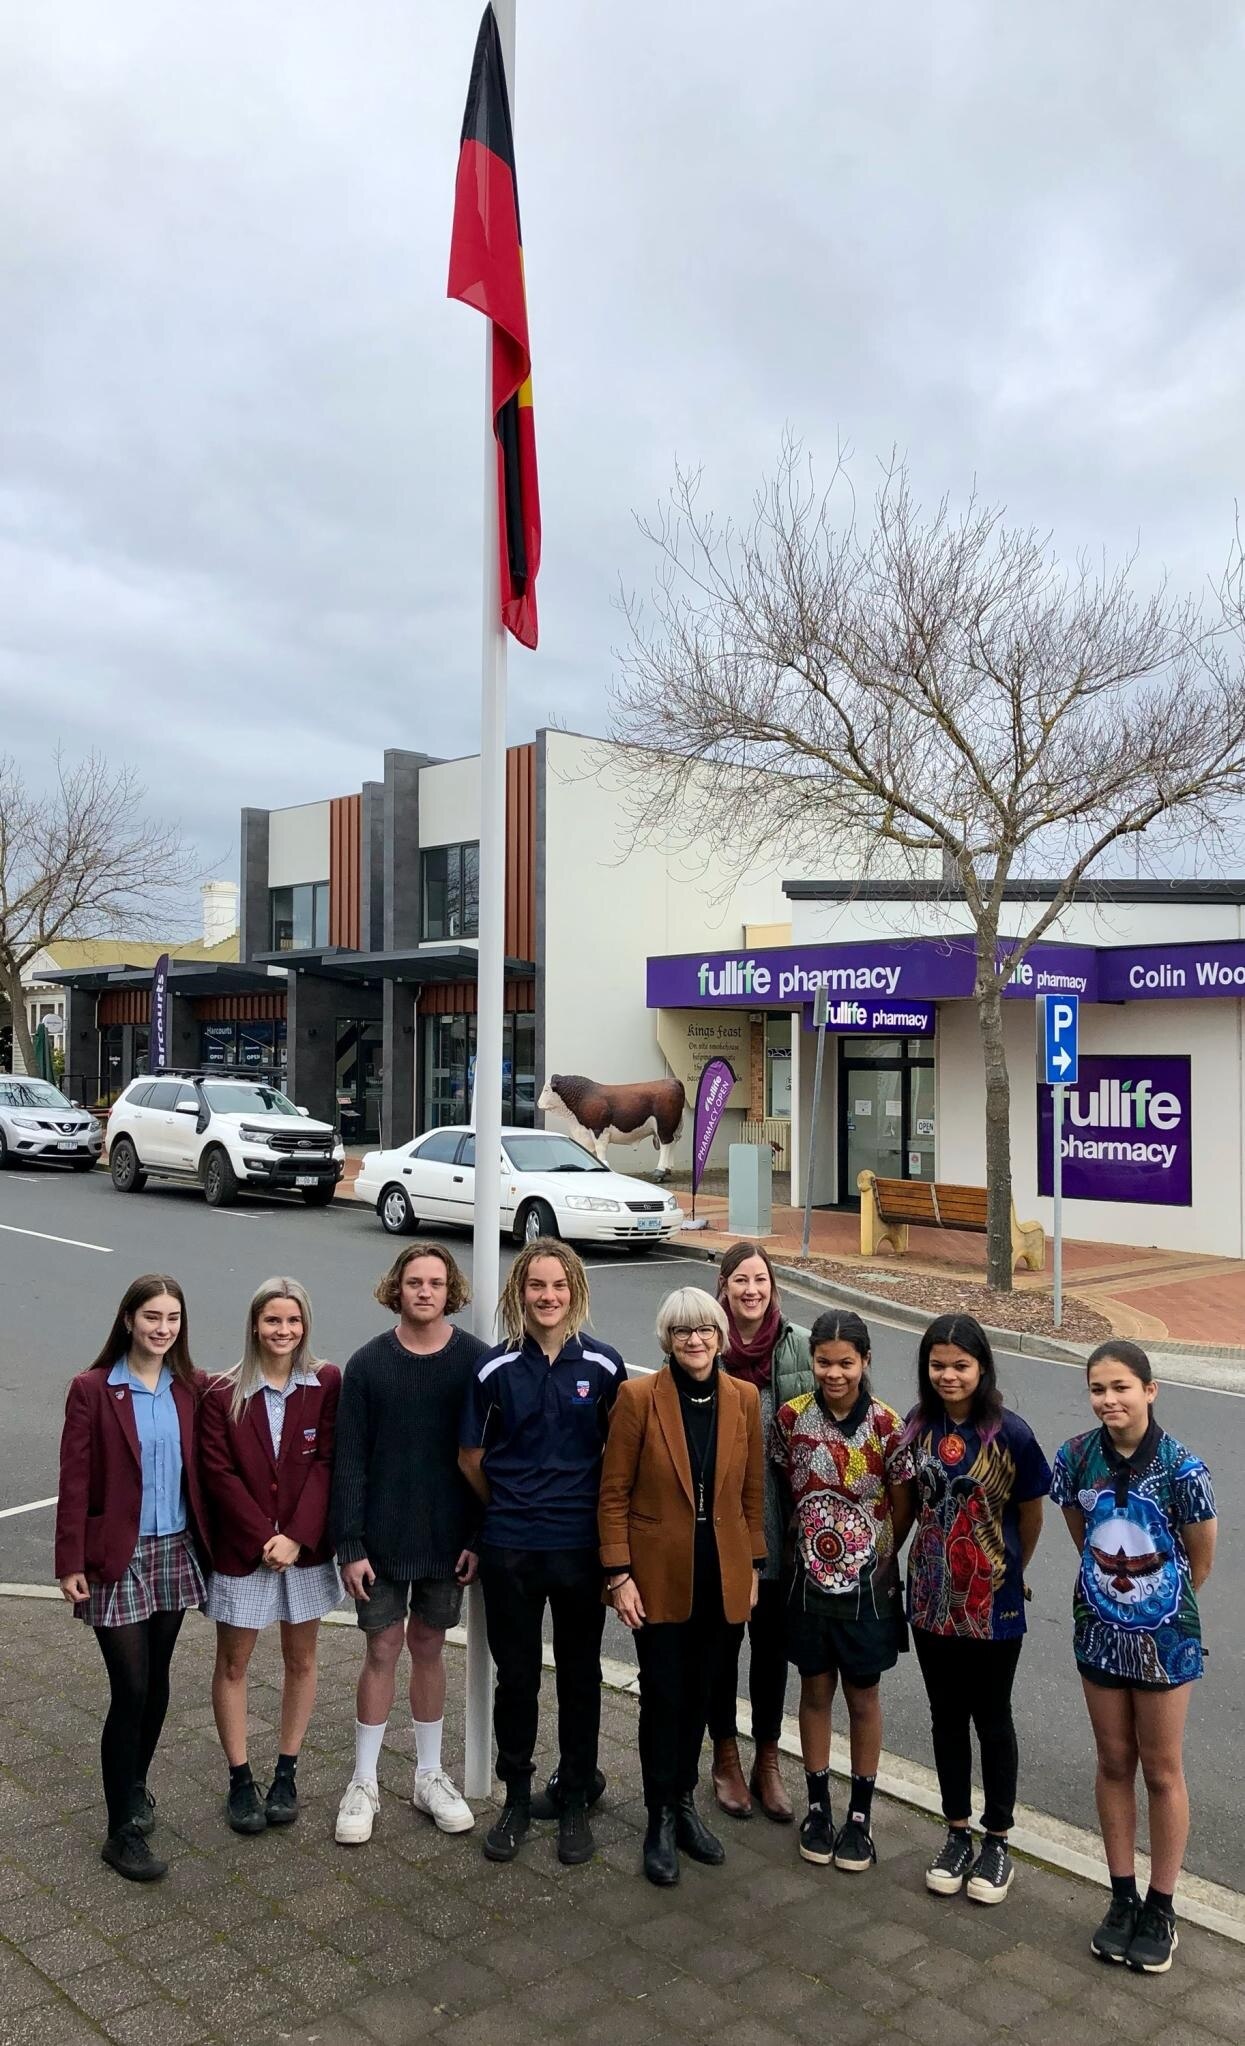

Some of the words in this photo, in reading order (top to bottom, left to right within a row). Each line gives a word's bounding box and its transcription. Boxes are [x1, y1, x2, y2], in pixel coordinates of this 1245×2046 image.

[698, 960, 771, 996] fullife
[779, 965, 902, 998] pharmacy
[1037, 970, 1087, 992] pharmacy
[1129, 964, 1186, 989] Colin
[826, 1001, 868, 1025] fullife
[872, 1009, 928, 1030] pharmacy
[1054, 1004, 1073, 1043] P
[698, 1107, 719, 1161] PHARMACY
[715, 1080, 729, 1107] OPEN
[918, 1122, 934, 1131] OPEN
